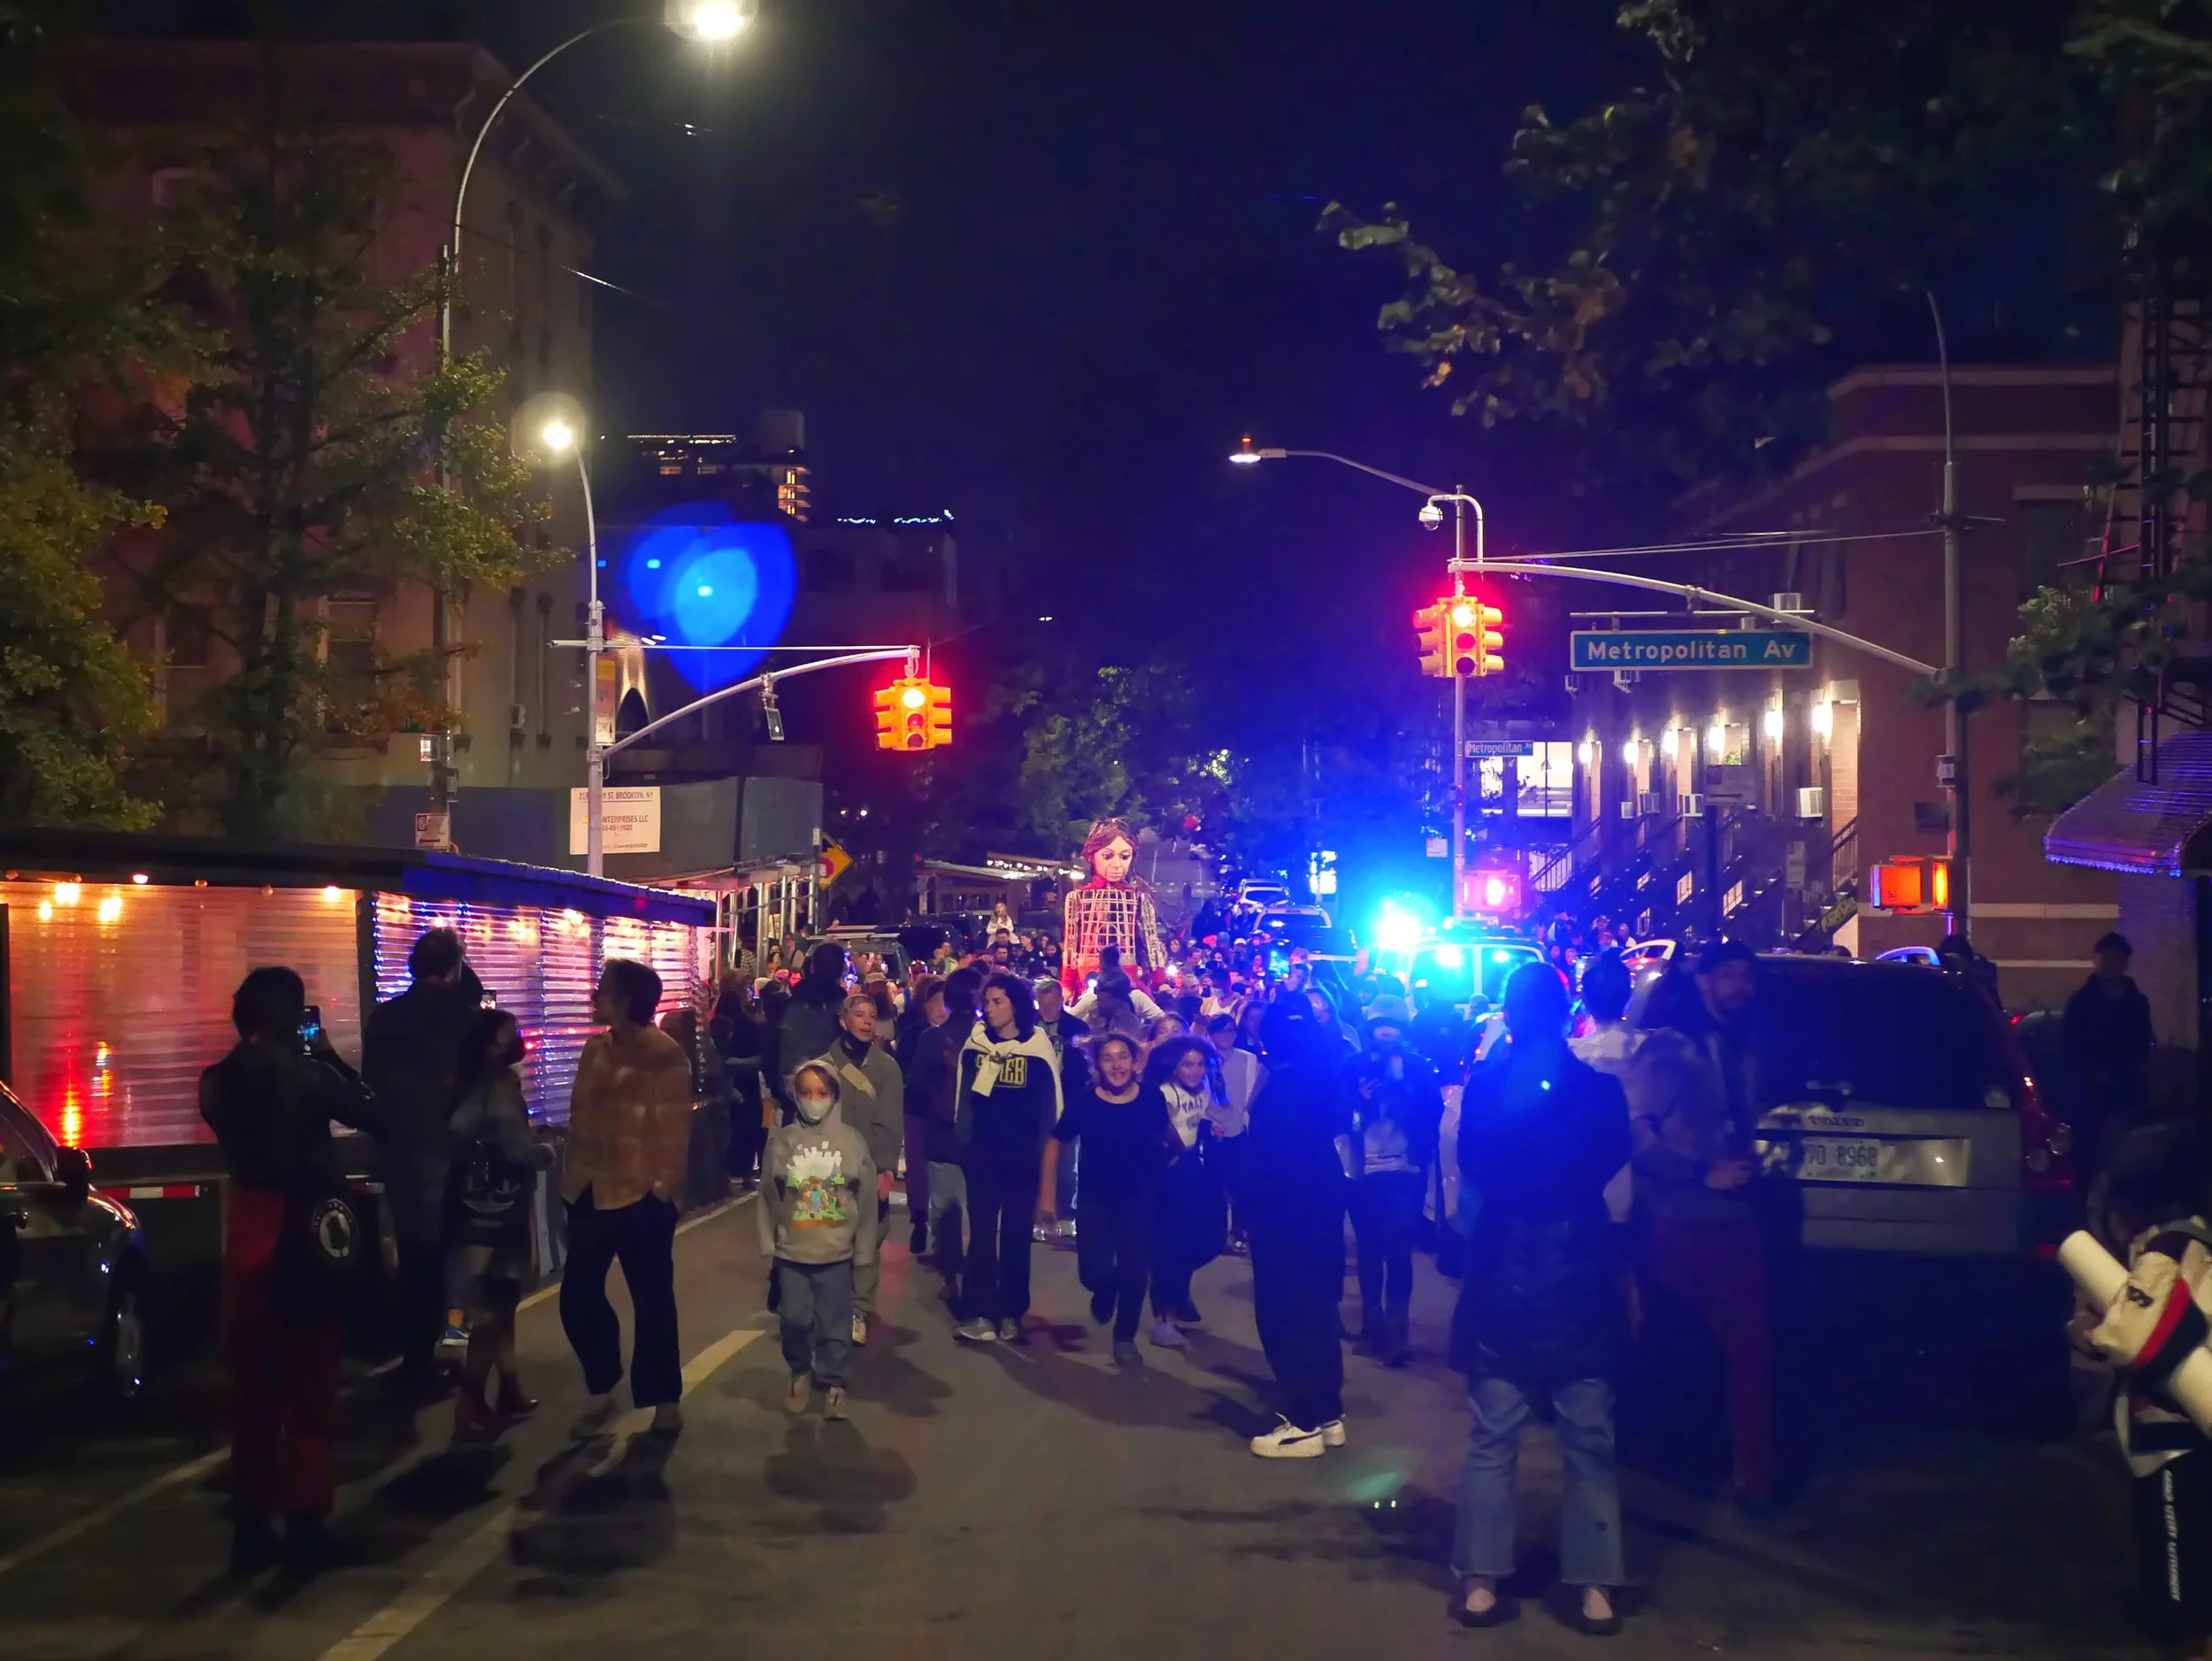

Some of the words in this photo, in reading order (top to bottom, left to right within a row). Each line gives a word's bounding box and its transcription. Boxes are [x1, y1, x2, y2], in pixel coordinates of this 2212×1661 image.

[1587, 641, 1747, 663] Metropolitan
[1763, 640, 1796, 658] Av
[1468, 742, 1522, 755] Metropolitan
[1836, 1145, 1878, 1167] 8968
